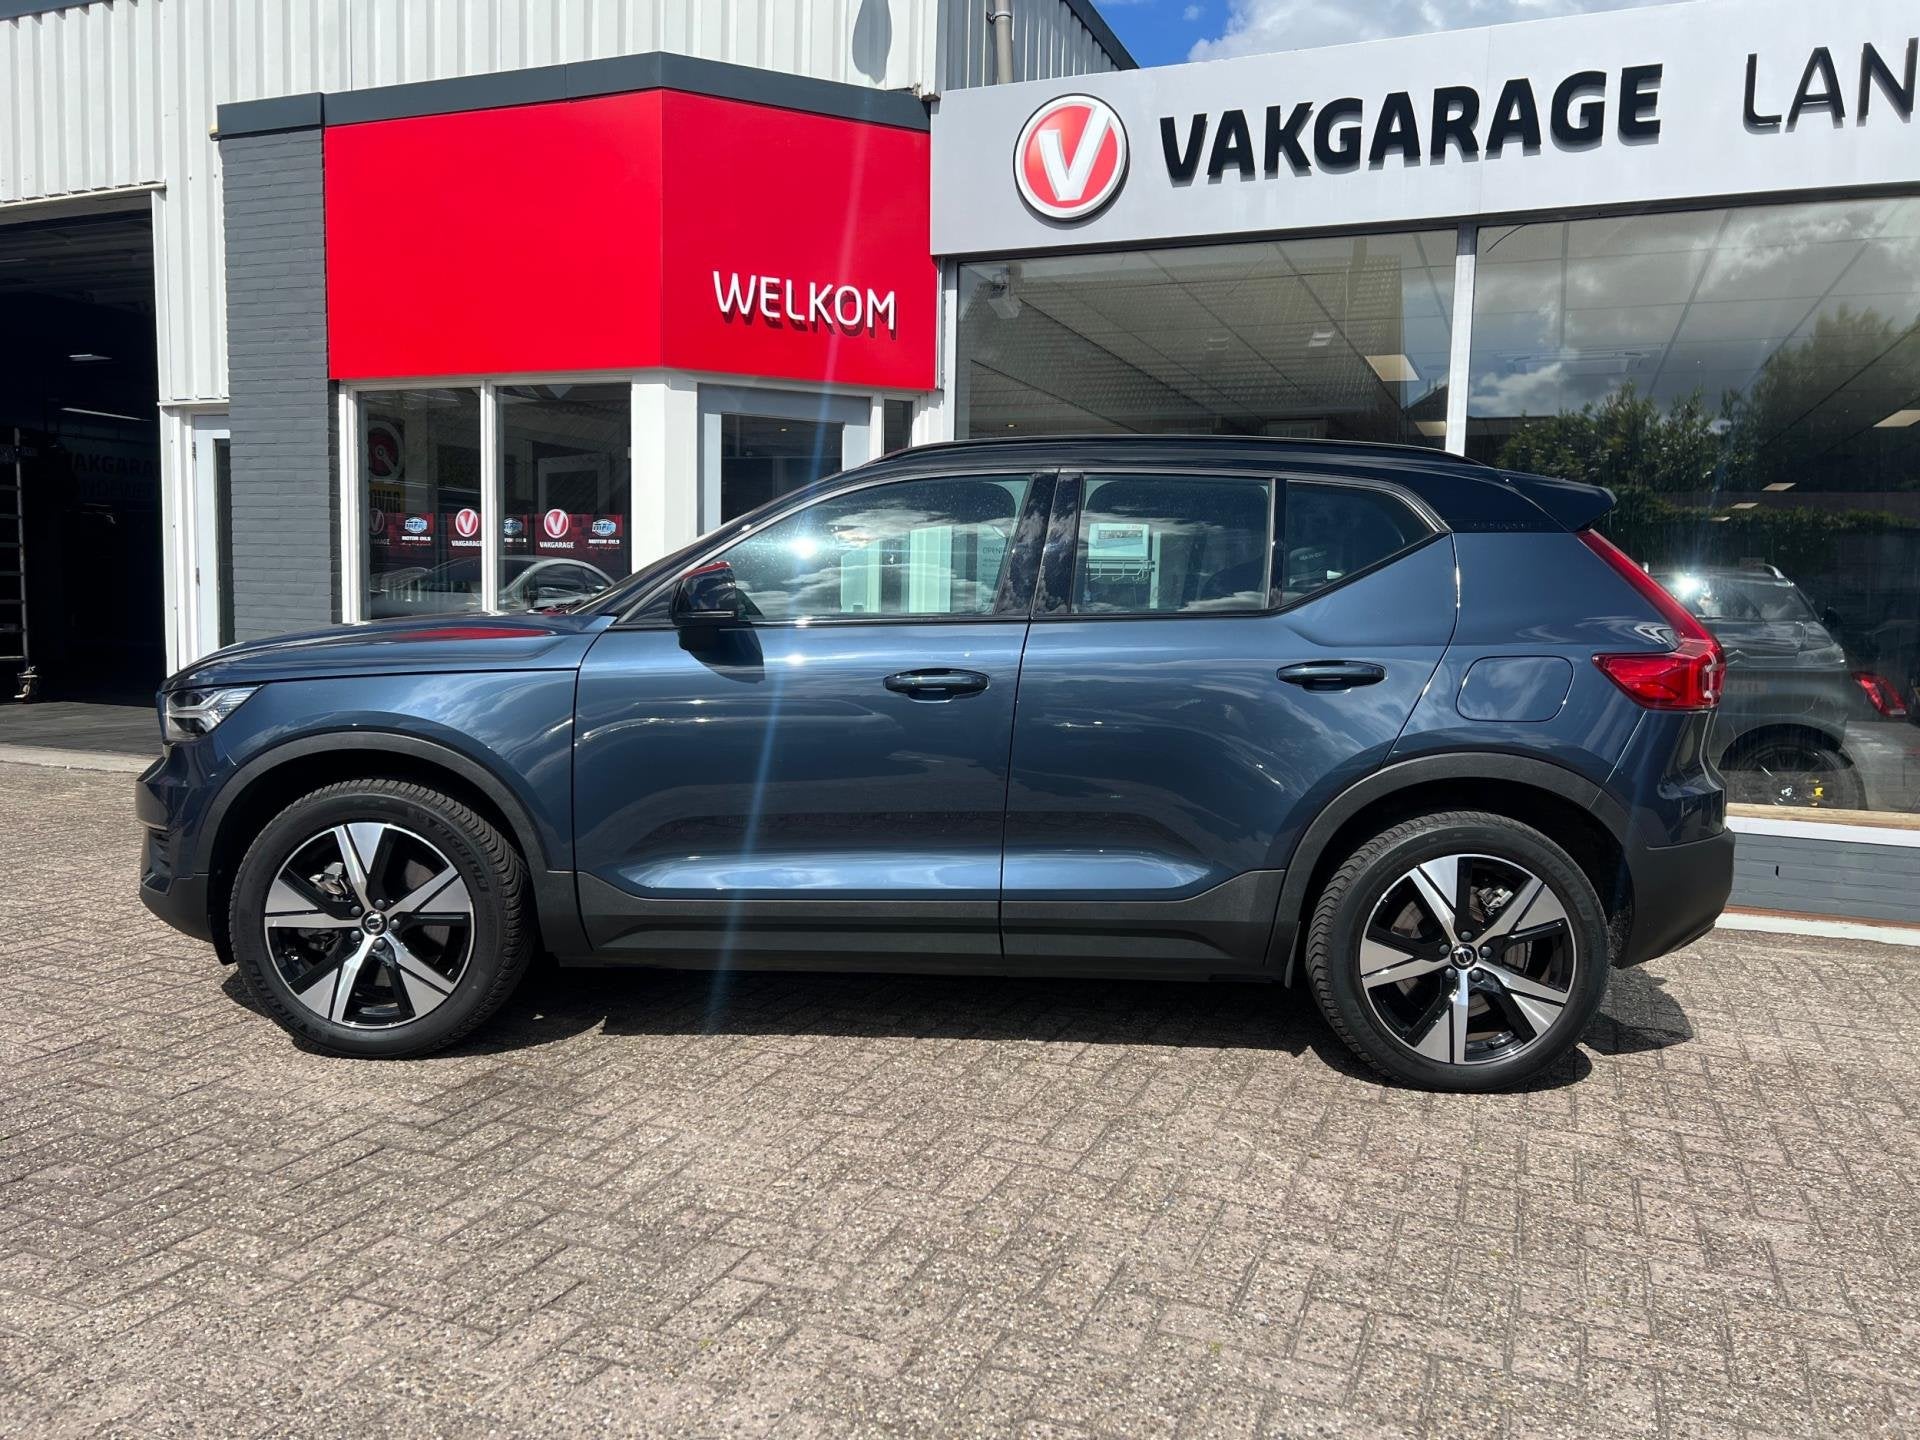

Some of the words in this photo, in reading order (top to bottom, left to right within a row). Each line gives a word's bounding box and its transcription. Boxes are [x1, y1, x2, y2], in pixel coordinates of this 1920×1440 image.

[1160, 64, 1663, 183] VAKGARAGE
[1743, 37, 1919, 132] LAN
[712, 270, 896, 332] WELKOM
[539, 541, 575, 549] VAKGARAGE
